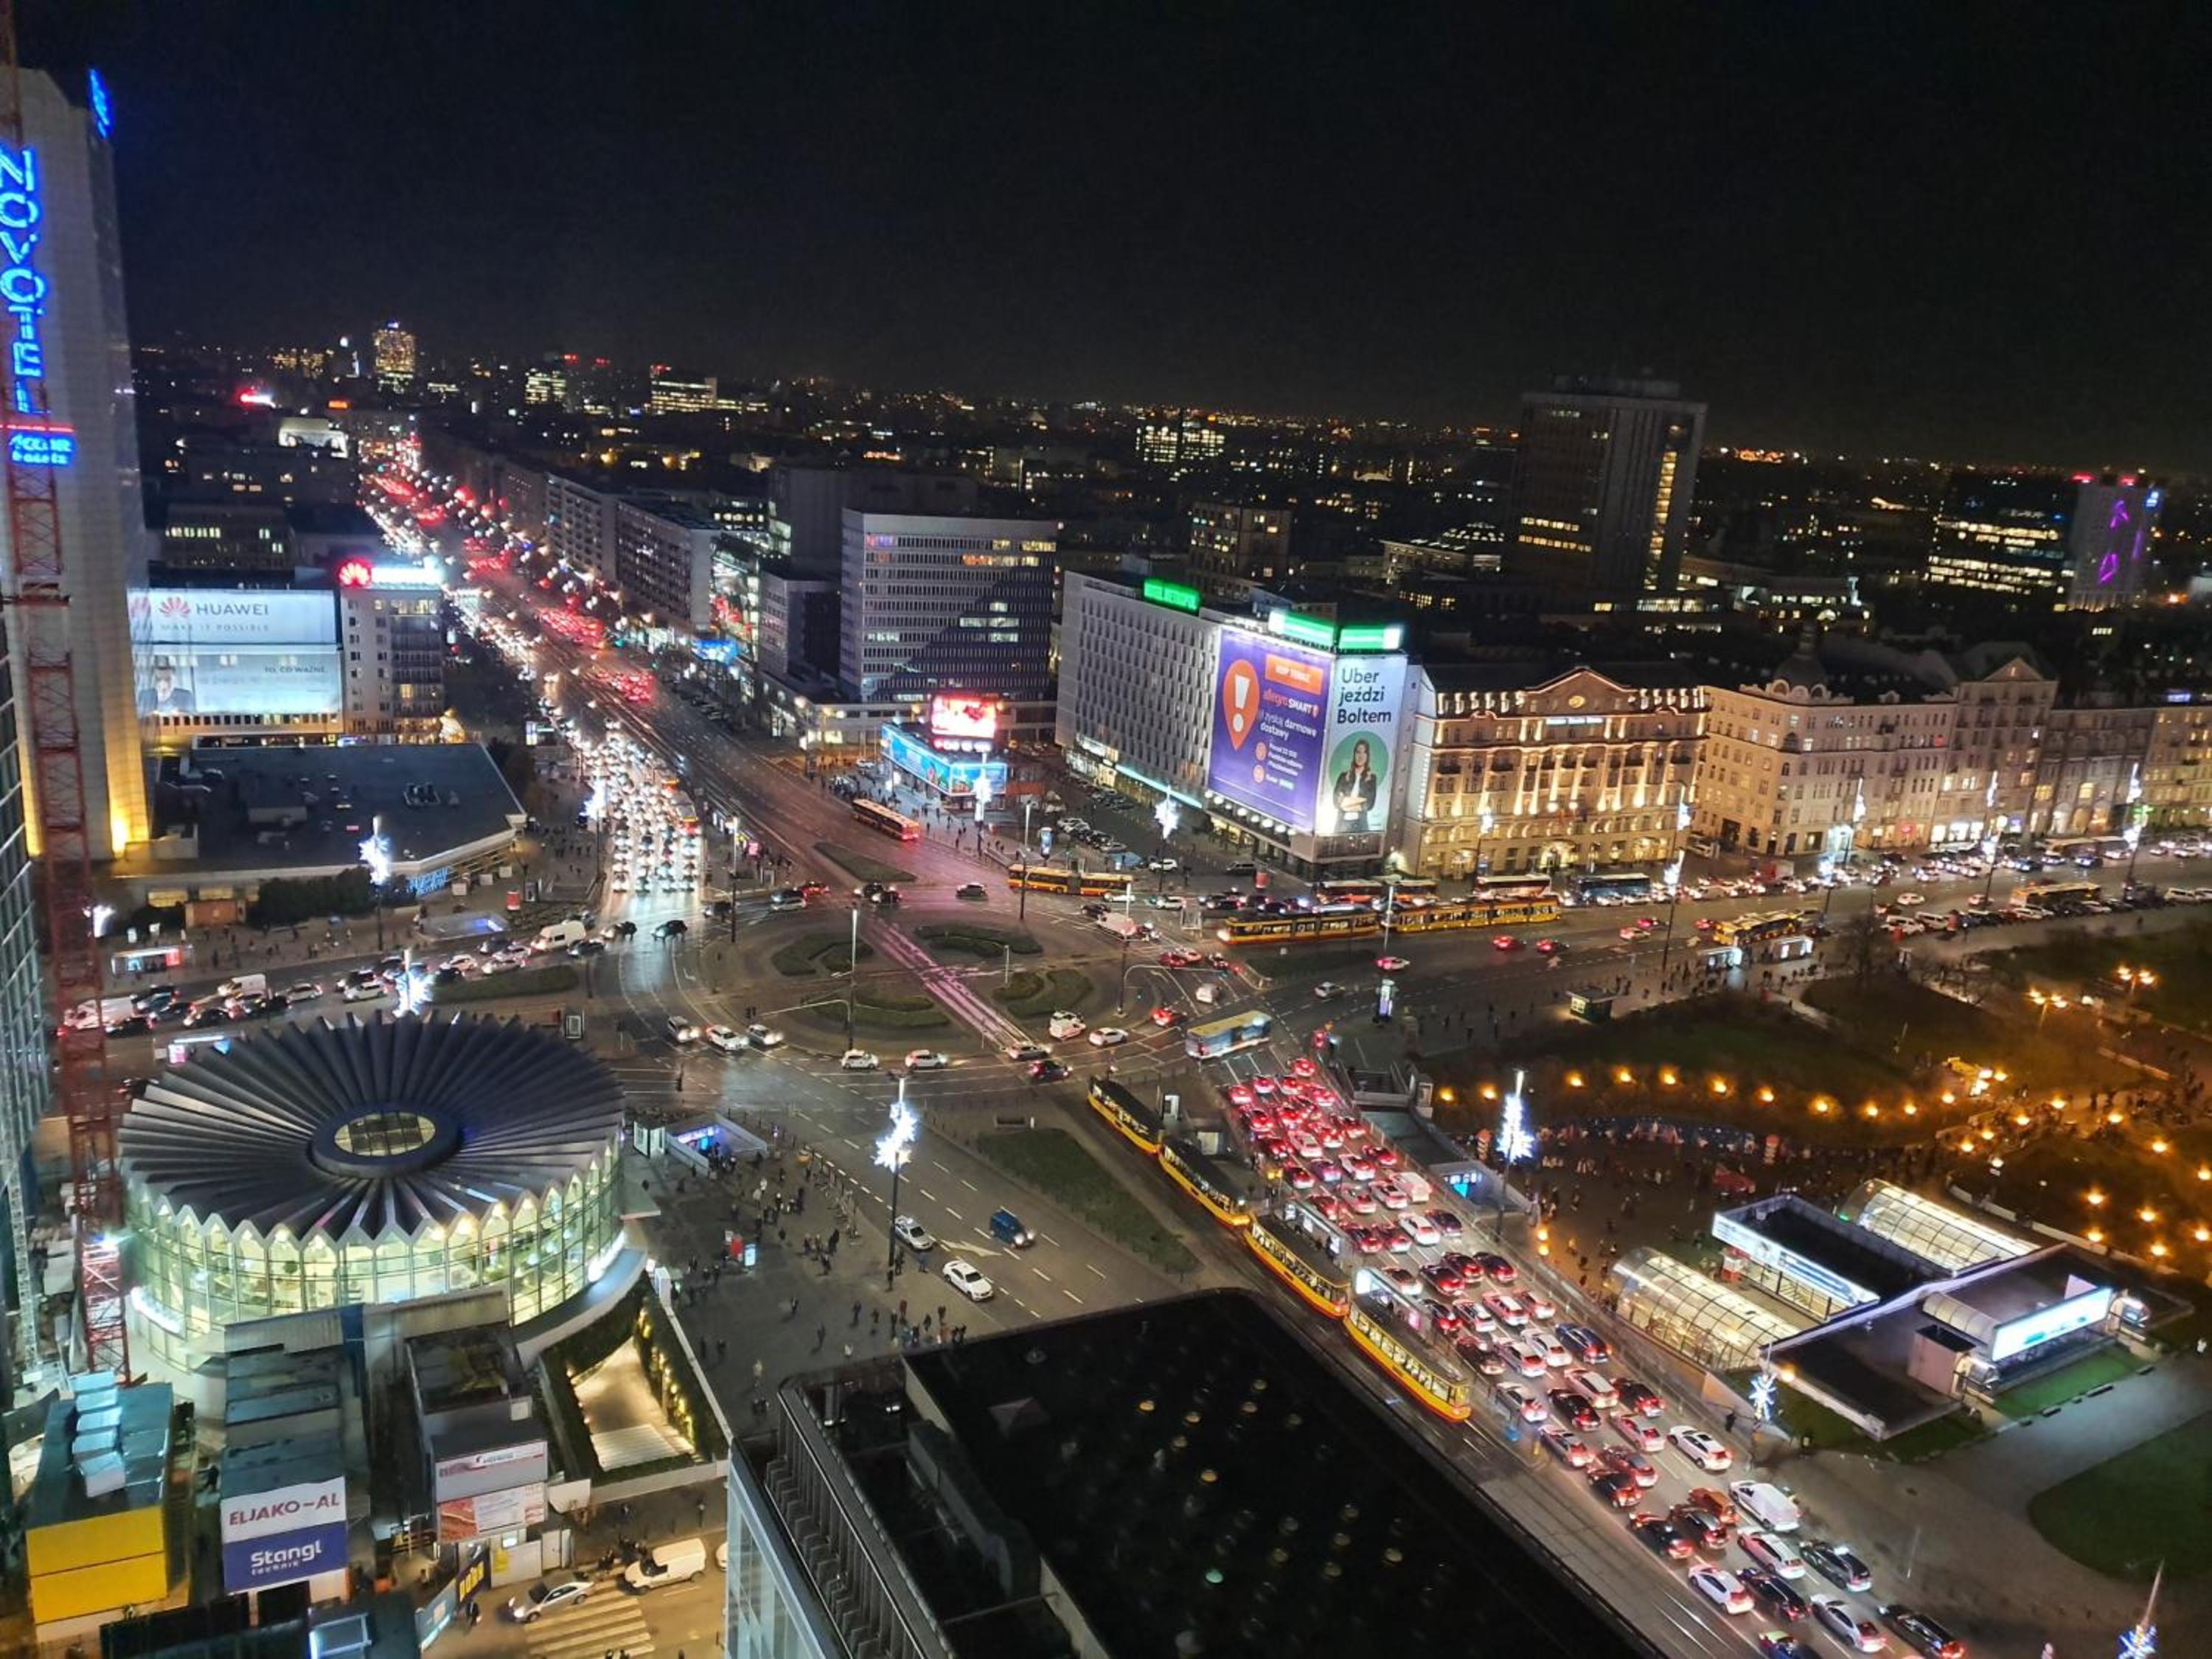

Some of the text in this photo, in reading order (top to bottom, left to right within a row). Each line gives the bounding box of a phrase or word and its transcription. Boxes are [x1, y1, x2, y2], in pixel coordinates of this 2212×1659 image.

[0, 150, 46, 414] NOVOTEL
[196, 603, 269, 616] HUAWEI
[1342, 667, 1380, 684] Uber
[1338, 686, 1385, 707] jeździ
[1338, 708, 1392, 723] Boltem
[229, 1493, 340, 1526] ELJAKO-AL
[251, 1540, 322, 1568] Stangl
